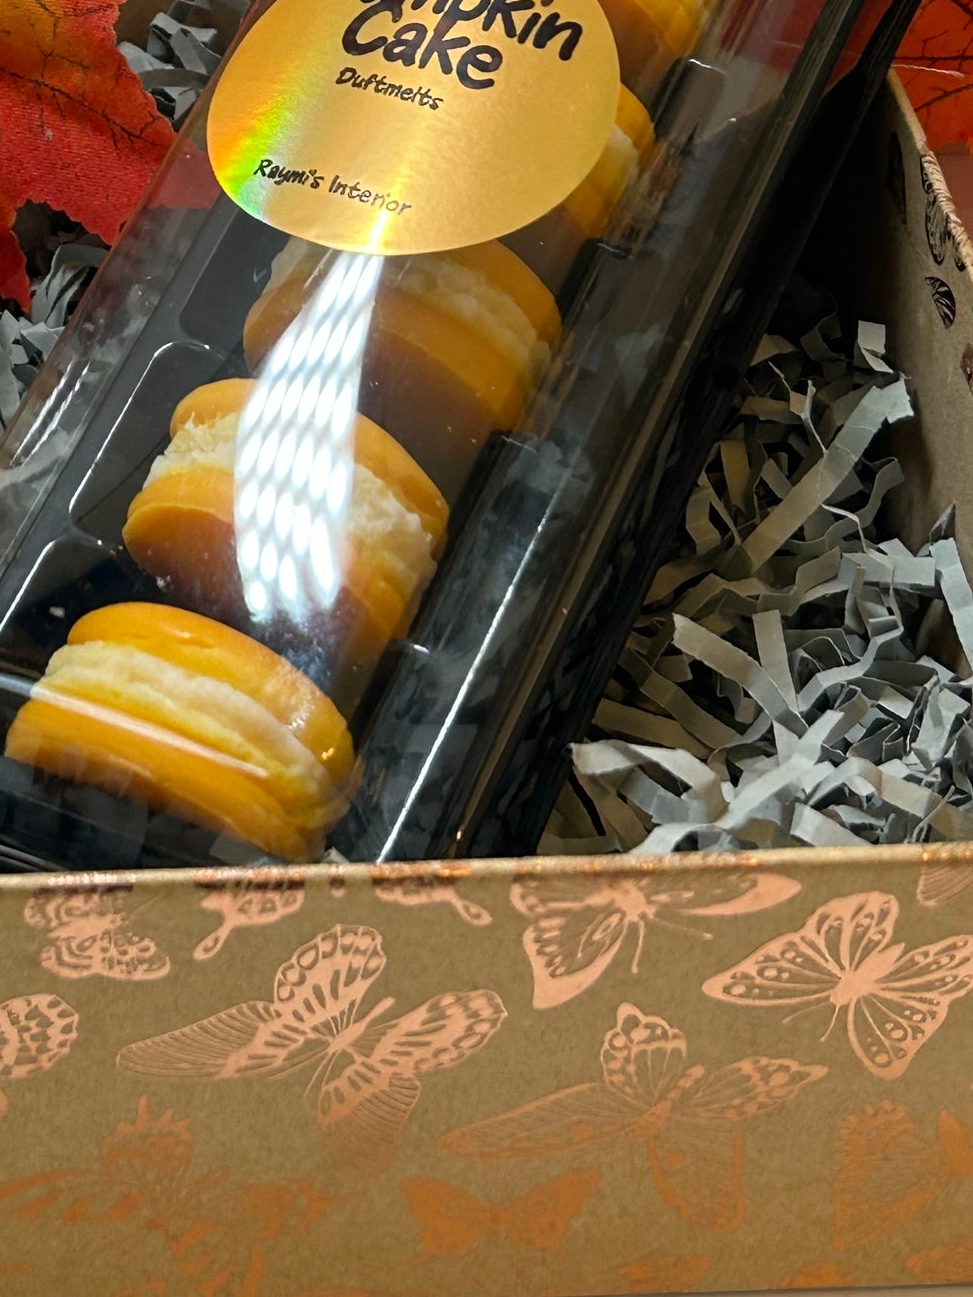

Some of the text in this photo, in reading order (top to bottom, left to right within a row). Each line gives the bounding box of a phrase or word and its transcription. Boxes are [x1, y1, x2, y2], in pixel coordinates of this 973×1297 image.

[342, 4, 503, 90] Cake
[335, 67, 444, 110] Duftmelts
[253, 158, 412, 215] Raymi's Interior
